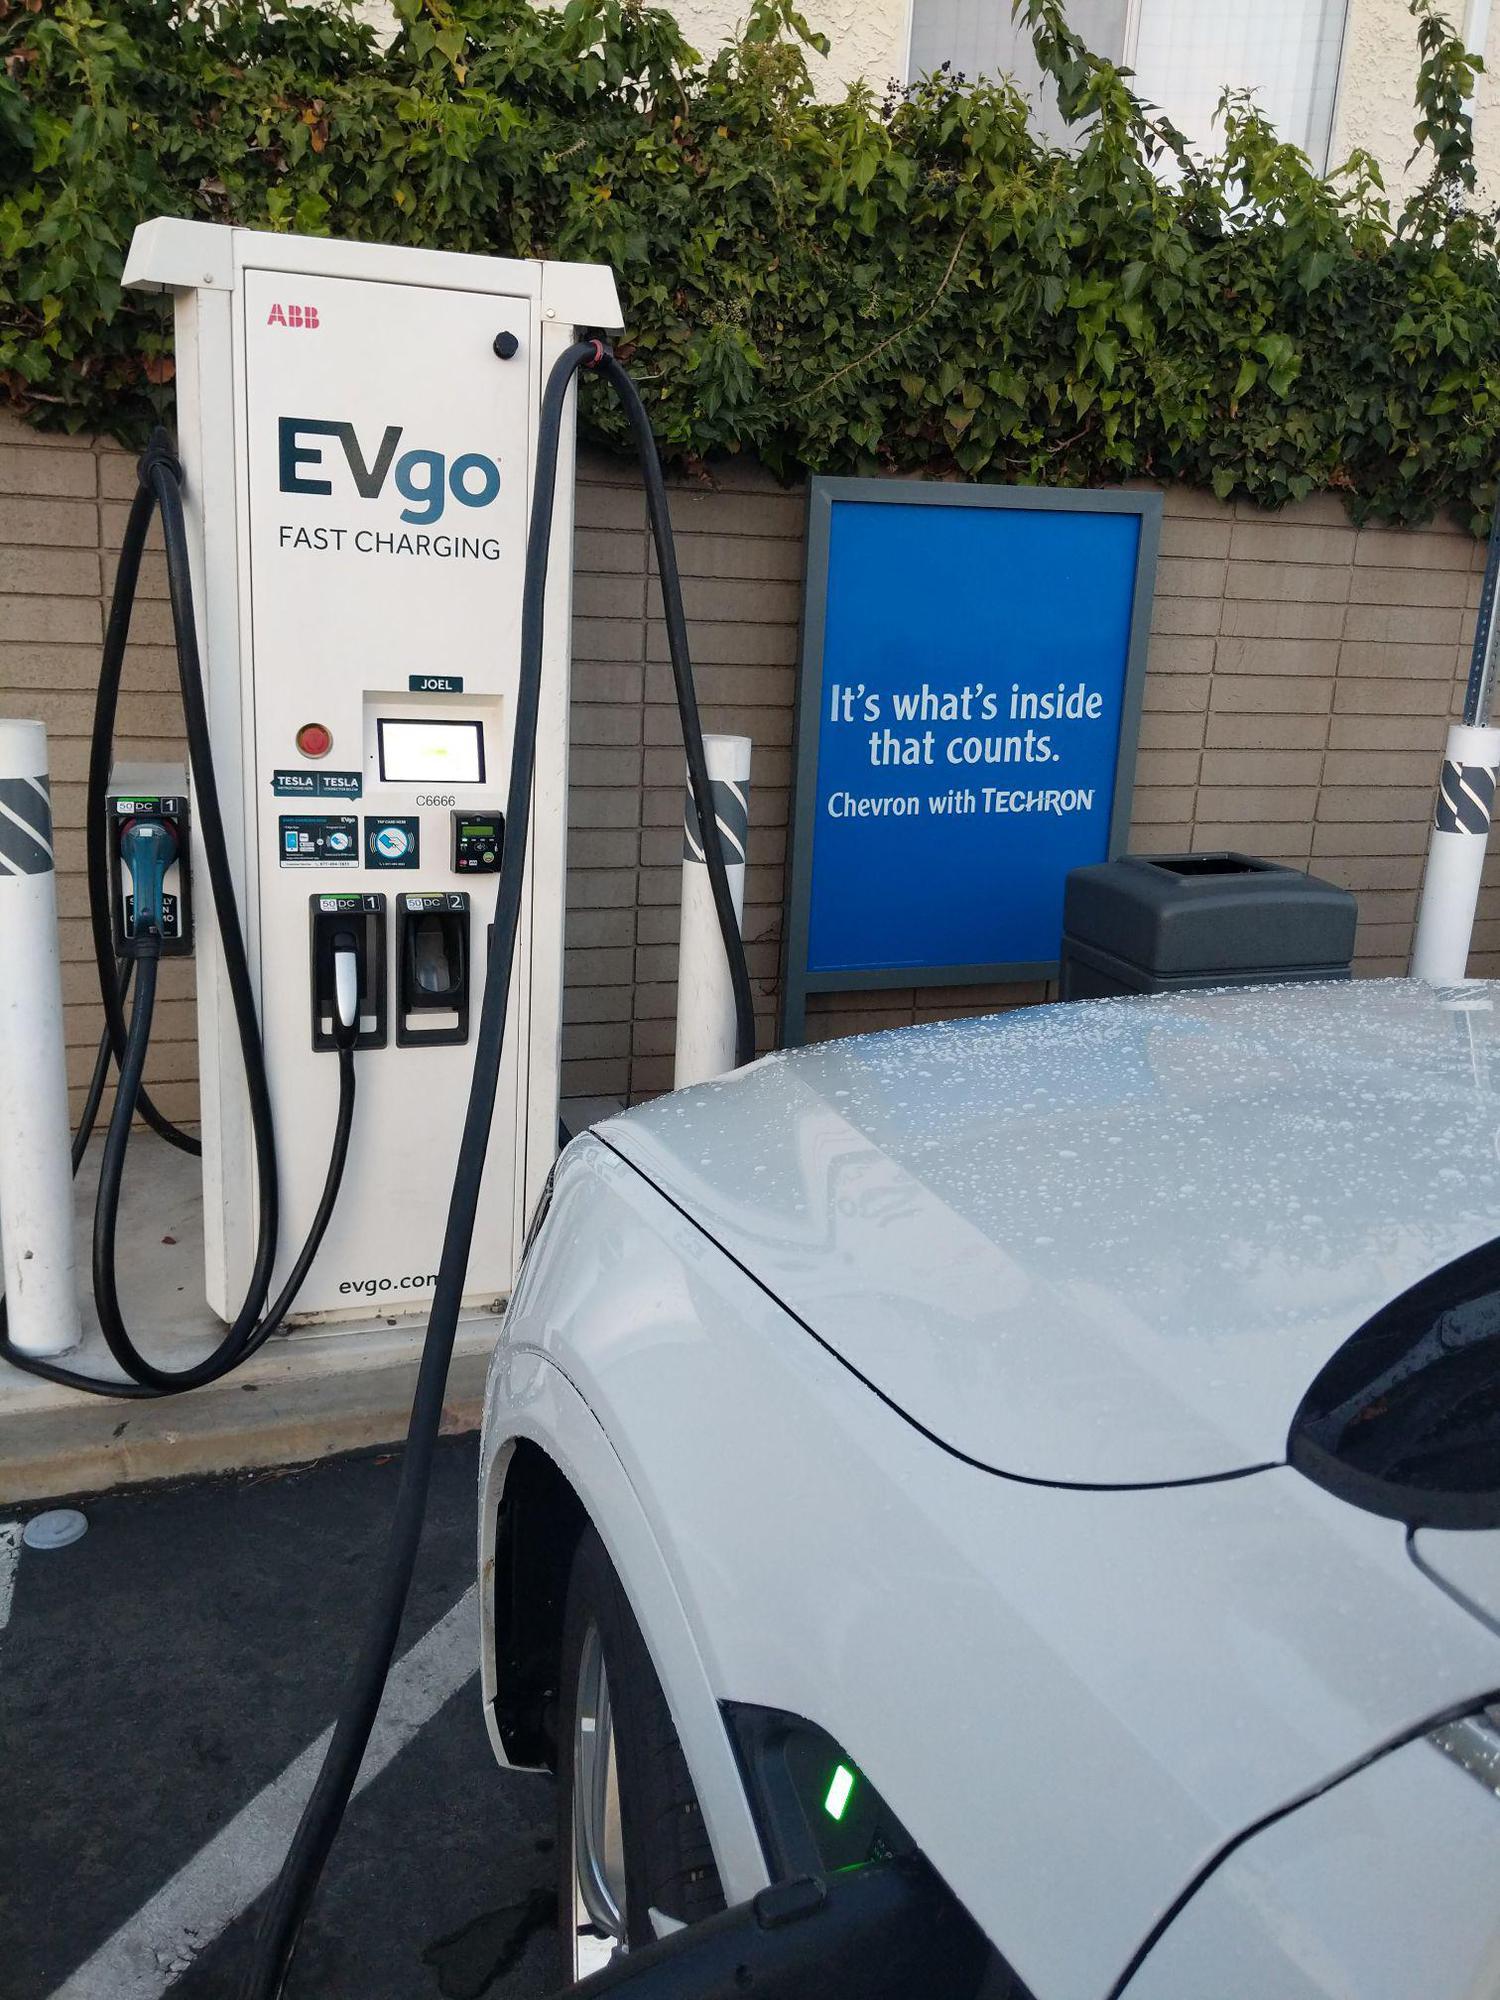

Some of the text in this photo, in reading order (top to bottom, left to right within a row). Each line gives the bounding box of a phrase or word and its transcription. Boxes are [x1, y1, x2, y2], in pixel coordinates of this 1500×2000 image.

[267, 303, 320, 329] ABB
[278, 416, 501, 525] EVgo
[279, 526, 500, 560] FAST CHARGING
[421, 679, 453, 691] JOEL
[831, 682, 1103, 722] It's what's inside
[869, 729, 1060, 766] that counts.
[277, 776, 313, 786] TESLA
[323, 778, 359, 787] TESLA
[136, 802, 153, 810] DC
[165, 800, 174, 811] 1
[416, 795, 456, 807] C6666
[828, 787, 1094, 818] Chevron with TECHRON
[338, 899, 355, 908] DC
[367, 896, 375, 909] 1
[424, 899, 440, 907] DC
[450, 895, 462, 908] 2
